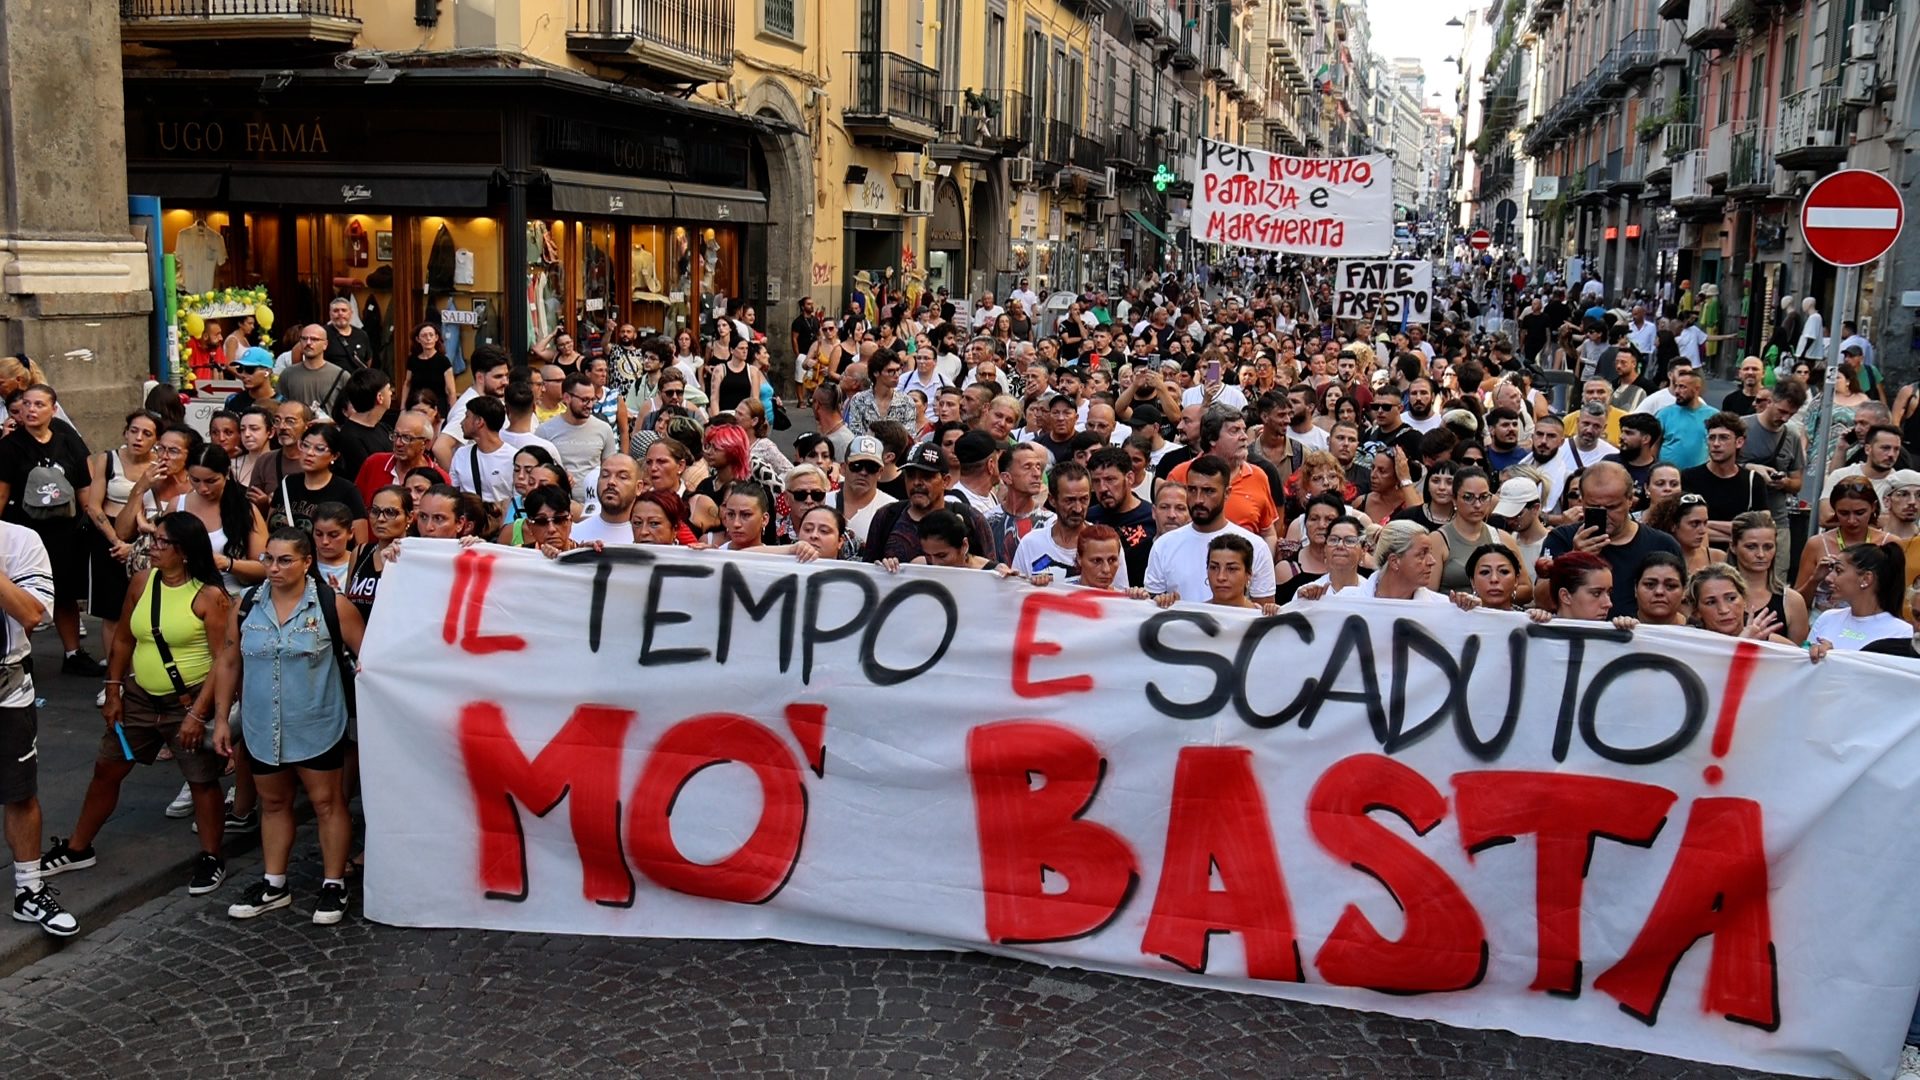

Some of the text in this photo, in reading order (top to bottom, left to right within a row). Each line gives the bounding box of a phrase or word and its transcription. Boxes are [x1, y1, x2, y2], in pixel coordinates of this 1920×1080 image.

[158, 121, 223, 151] UGO
[613, 138, 645, 169] UGO
[1309, 186, 1330, 209] e
[1346, 262, 1415, 289] FATE
[442, 310, 477, 324] SALDI
[1336, 290, 1428, 316] PRESTO
[442, 549, 527, 654] IL
[558, 545, 958, 686] TEMPO
[1138, 610, 1760, 786] SCADUTO!
[966, 718, 1781, 1032] BASTA
